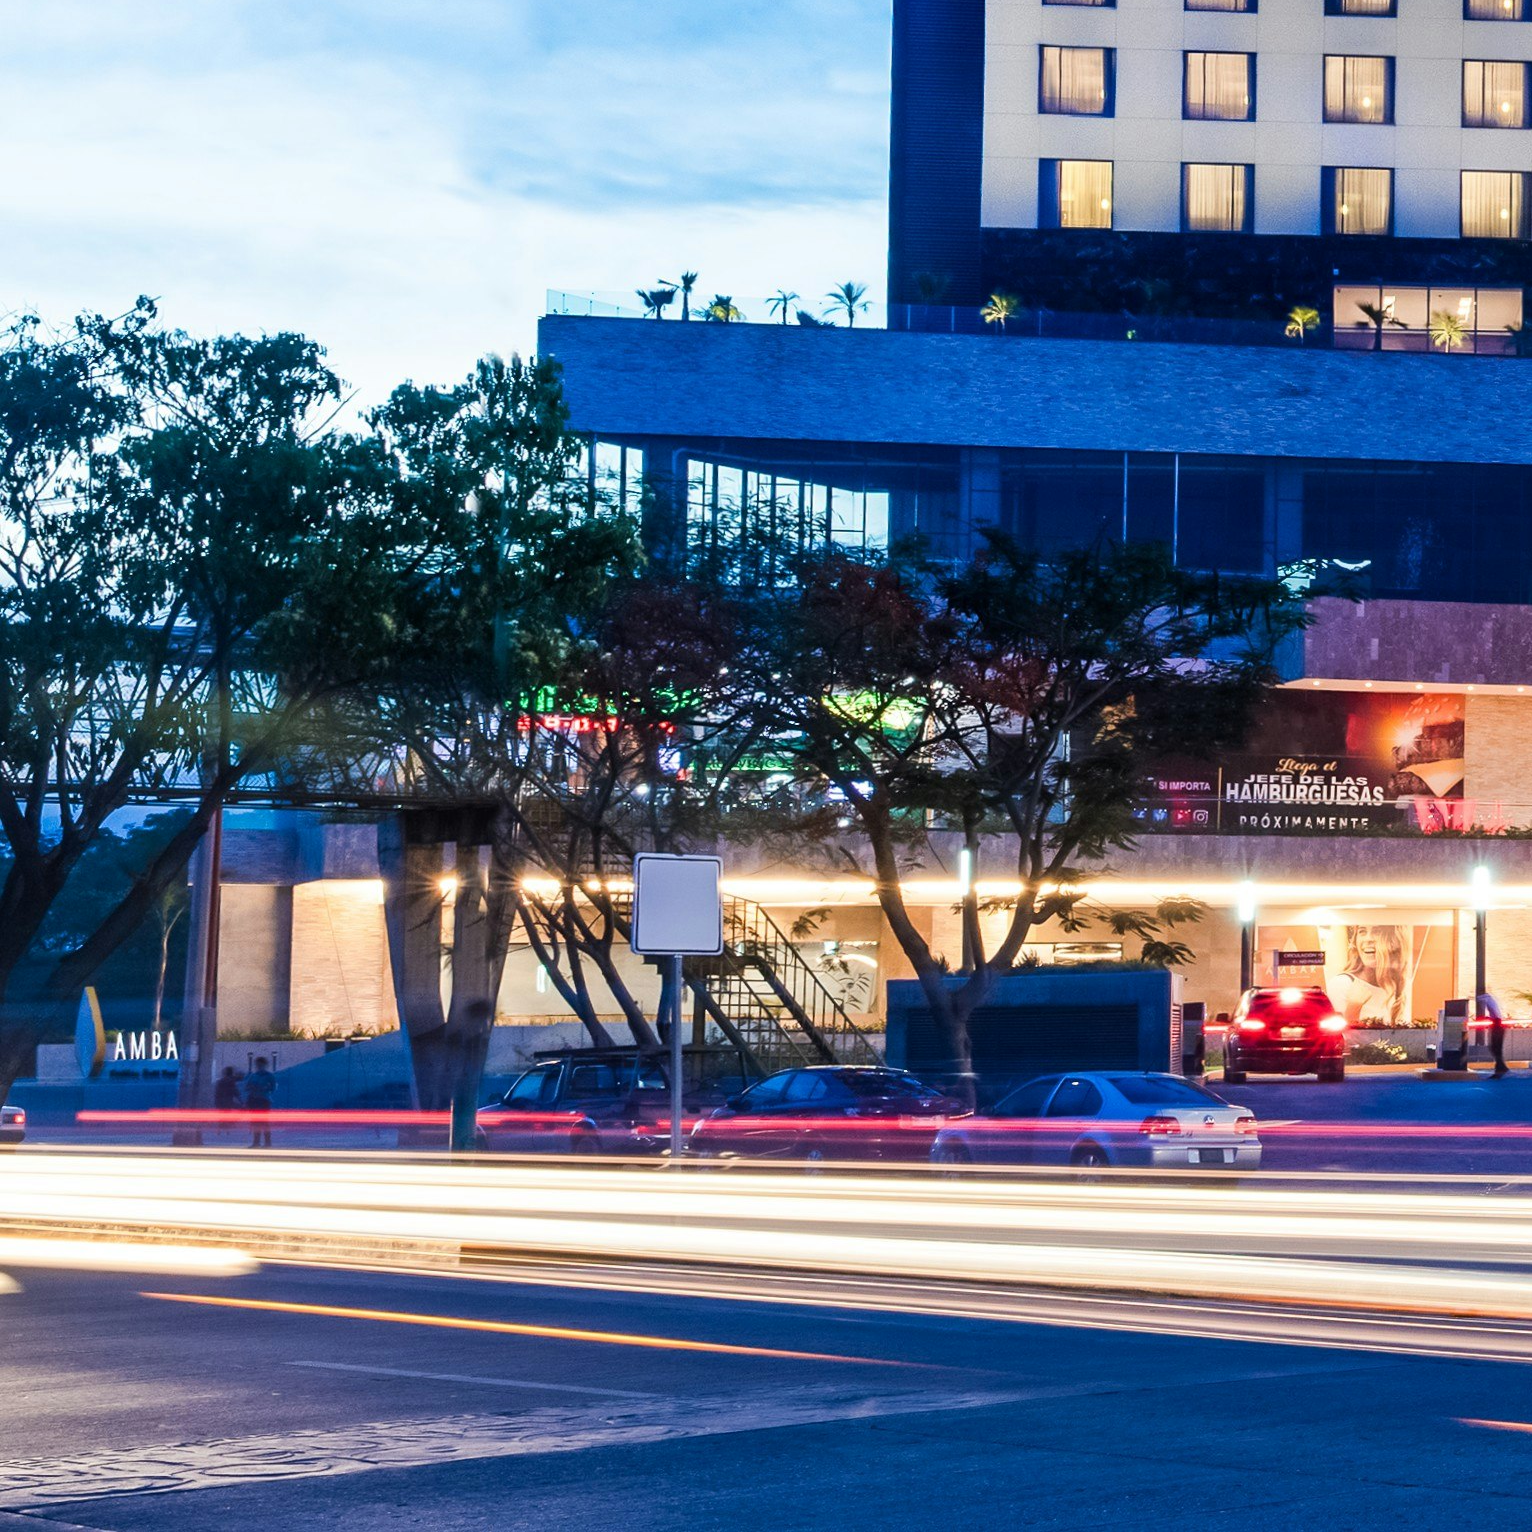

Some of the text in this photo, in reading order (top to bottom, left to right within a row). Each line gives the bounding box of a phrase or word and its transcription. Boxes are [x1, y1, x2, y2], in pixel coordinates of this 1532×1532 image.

[1275, 758, 1337, 776] Llega el
[1169, 782, 1211, 791] IMPORTA
[1244, 774, 1368, 785] JEFE DE LAS
[1226, 783, 1384, 806] HAMBURGUESAS
[1240, 813, 1369, 830] PRÓXIMAMENTE
[114, 1030, 179, 1060] AMBA
